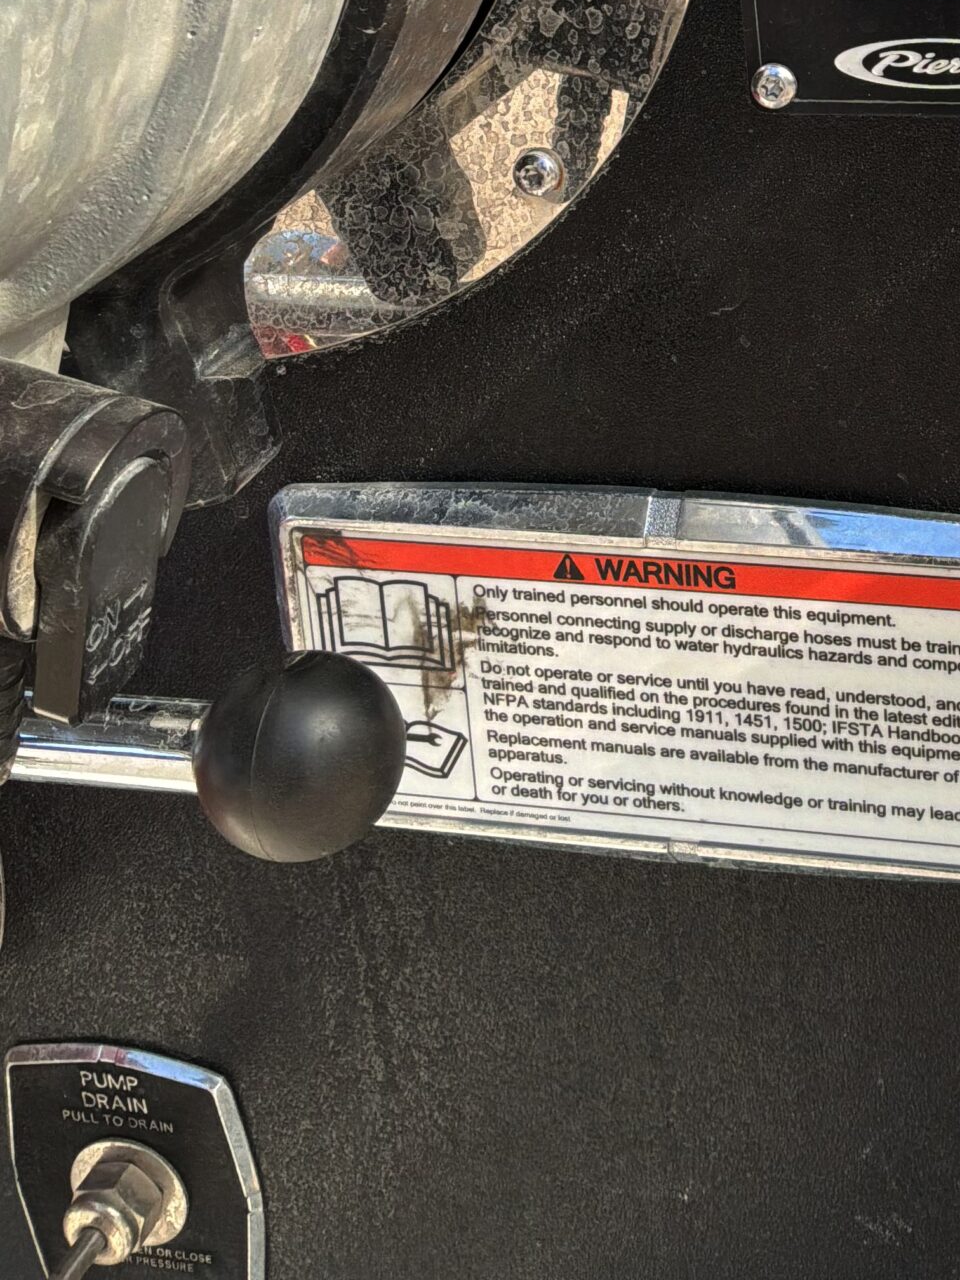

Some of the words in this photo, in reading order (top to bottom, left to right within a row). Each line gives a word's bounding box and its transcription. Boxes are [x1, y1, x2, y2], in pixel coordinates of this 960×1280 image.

[595, 557, 737, 589] WARNING
[472, 585, 508, 603] Only
[512, 588, 565, 604] trained
[570, 594, 646, 610] personnel
[651, 598, 703, 614] should
[707, 604, 769, 618] operate
[772, 606, 801, 621] this
[805, 610, 895, 627] equipment.
[476, 607, 551, 625] Personnel
[556, 615, 640, 634] connecting
[645, 622, 696, 639] supply
[701, 626, 717, 637] or
[720, 625, 799, 645] discharge
[803, 631, 851, 647] hoses
[856, 637, 896, 650] must
[900, 638, 921, 652] be
[477, 626, 550, 642] recognize
[554, 630, 583, 644] and
[588, 634, 651, 649] respond
[655, 637, 670, 650] to
[674, 639, 719, 654] water
[723, 641, 803, 660] hydraulics
[807, 647, 872, 665] hazards
[876, 654, 907, 668] and
[478, 637, 558, 657] limitations.
[480, 659, 502, 674] Do
[506, 663, 529, 676] not
[534, 666, 592, 681] operate
[597, 671, 613, 683] or
[616, 673, 672, 688] service
[676, 677, 708, 691] until
[713, 681, 741, 695] you
[746, 681, 785, 697] have
[789, 686, 830, 703] read,
[835, 690, 930, 711] understood,
[482, 676, 533, 693] trained
[537, 682, 566, 696] and
[570, 685, 634, 701] qualified
[640, 691, 658, 703] on
[663, 691, 688, 706] the
[692, 696, 781, 713] procedures
[784, 701, 830, 717] found
[834, 705, 848, 719] in
[853, 707, 879, 721] the
[883, 709, 927, 725] latest
[483, 691, 528, 708] NFPA
[532, 697, 607, 714] standards
[611, 702, 680, 723] including
[686, 708, 728, 726] 1911,
[734, 712, 777, 731] 1451,
[783, 716, 826, 735] 1500;
[831, 721, 883, 738] IFSTA
[484, 708, 507, 722] the
[512, 713, 582, 729] operation
[587, 718, 616, 732] and
[620, 722, 675, 737] service
[680, 727, 746, 743] manuals
[750, 733, 817, 749] supplied
[821, 737, 853, 752] with
[857, 740, 886, 755] this
[486, 729, 586, 750] Replacement
[590, 740, 655, 756] manuals
[660, 747, 685, 759] are
[689, 748, 759, 765] available
[762, 753, 798, 769] from
[802, 757, 828, 771] the
[832, 762, 939, 781] manufacturer
[942, 769, 959, 783] of
[487, 747, 567, 764] apparatus.
[81, 1070, 139, 1092] PUMP
[62, 1110, 98, 1123] PULL
[103, 1114, 123, 1126] TO
[129, 1118, 173, 1133] DRAIN
[82, 1092, 148, 1114] DRAIN
[136, 1255, 194, 1272] PRESSURE
[174, 1250, 212, 1265] CLOSE
